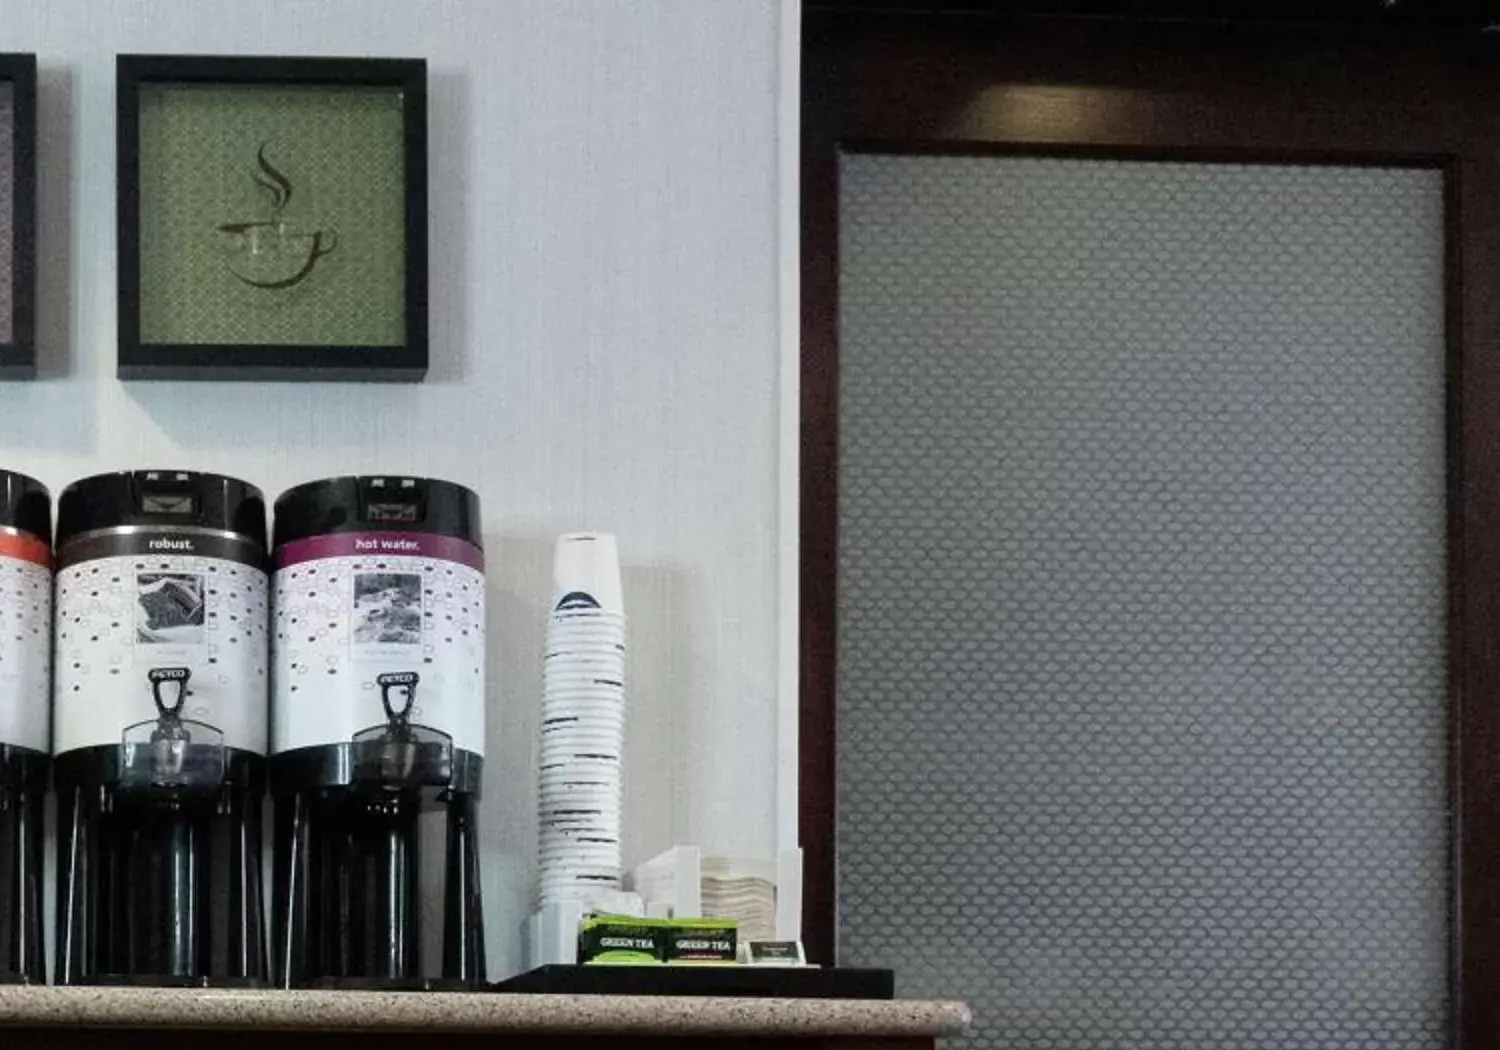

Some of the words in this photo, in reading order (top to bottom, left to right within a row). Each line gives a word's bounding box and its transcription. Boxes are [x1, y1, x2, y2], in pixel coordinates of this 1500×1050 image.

[148, 538, 195, 550] robust.
[355, 538, 378, 549] hot
[381, 539, 421, 550] water.
[600, 937, 635, 949] GREEN
[636, 938, 655, 950] TEA
[711, 940, 731, 951] TEA
